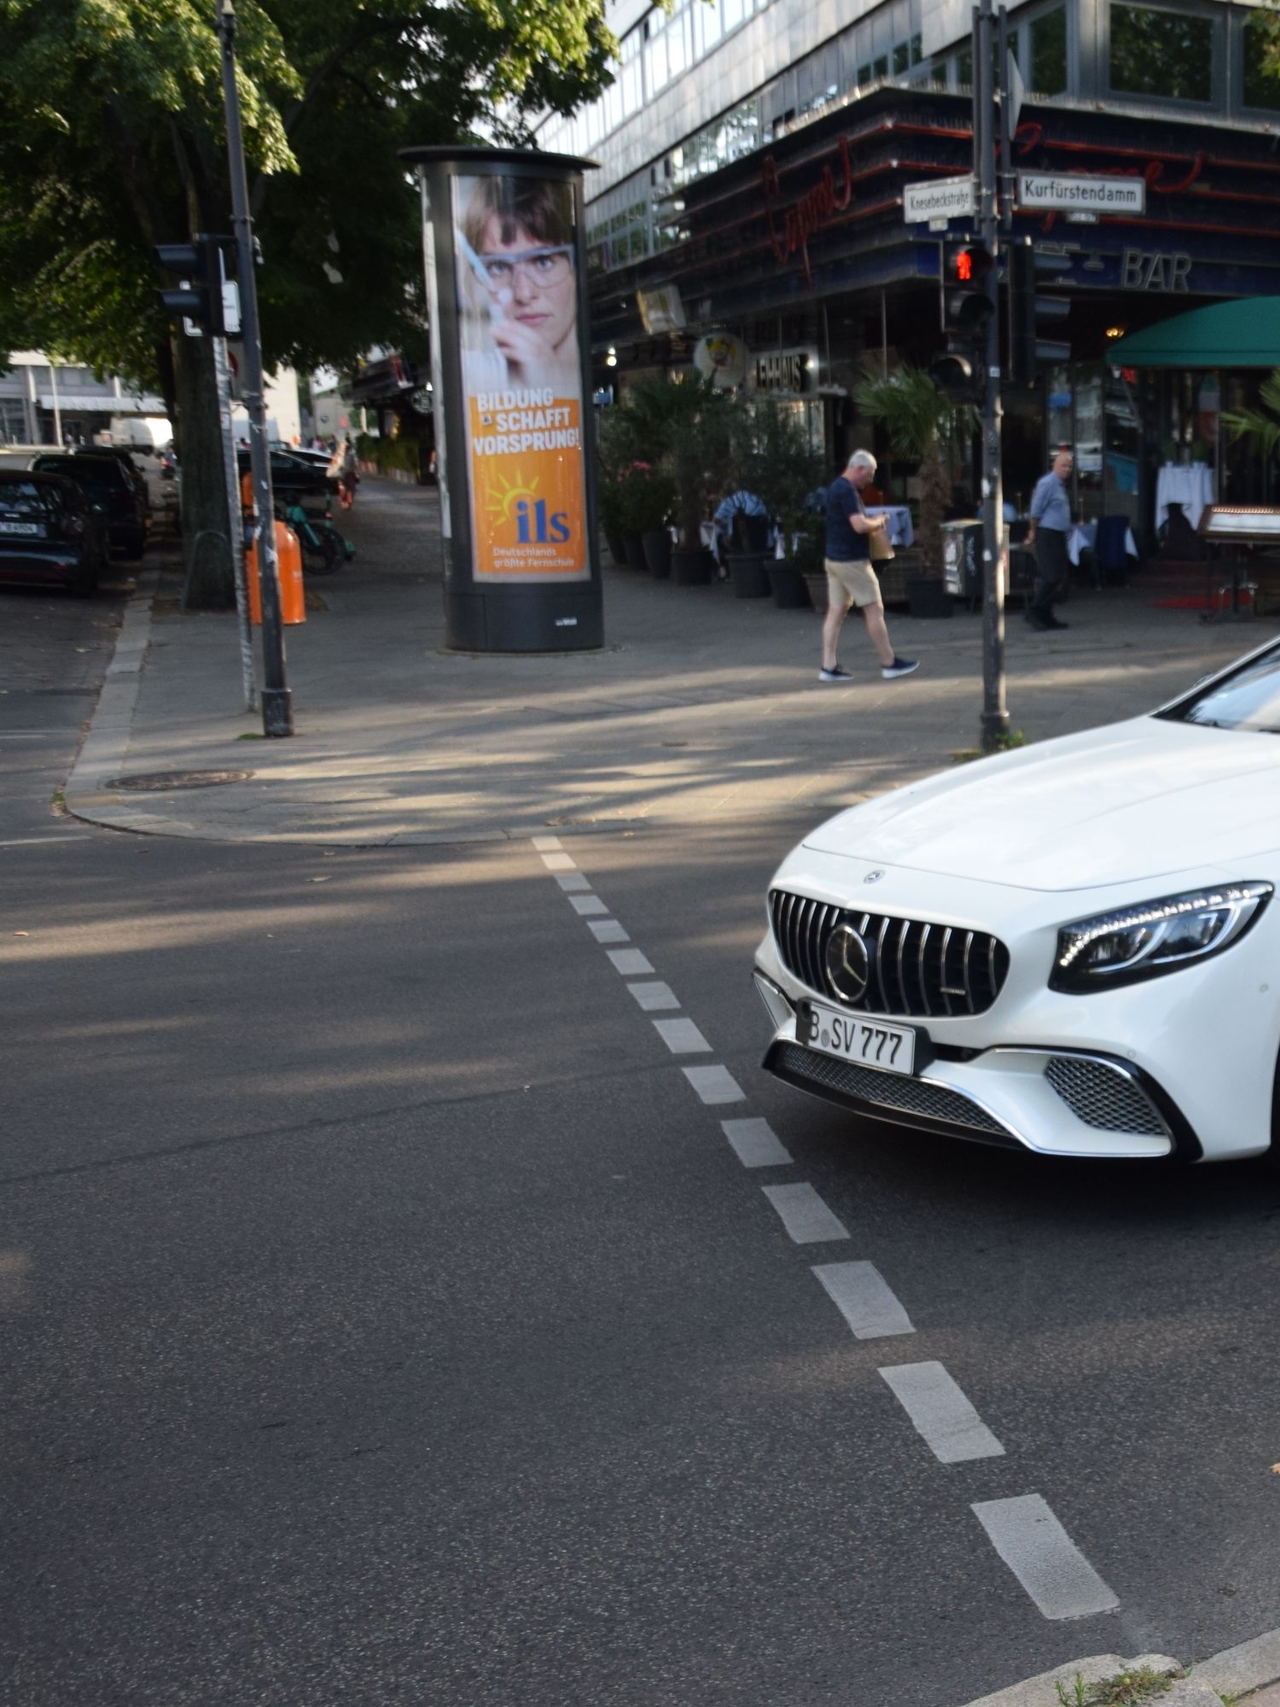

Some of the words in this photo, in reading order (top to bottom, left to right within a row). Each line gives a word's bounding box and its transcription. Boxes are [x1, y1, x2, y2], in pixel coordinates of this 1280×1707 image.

[1025, 180, 1137, 204] Kurfürstendamm
[1120, 248, 1193, 293] BAR
[477, 387, 553, 412] BILDUNG
[496, 407, 570, 432] SCHAFFT
[473, 427, 580, 456] VORSPRUNG!
[516, 498, 571, 544] ils
[831, 1018, 856, 1053] SV
[861, 1026, 902, 1064] 777
